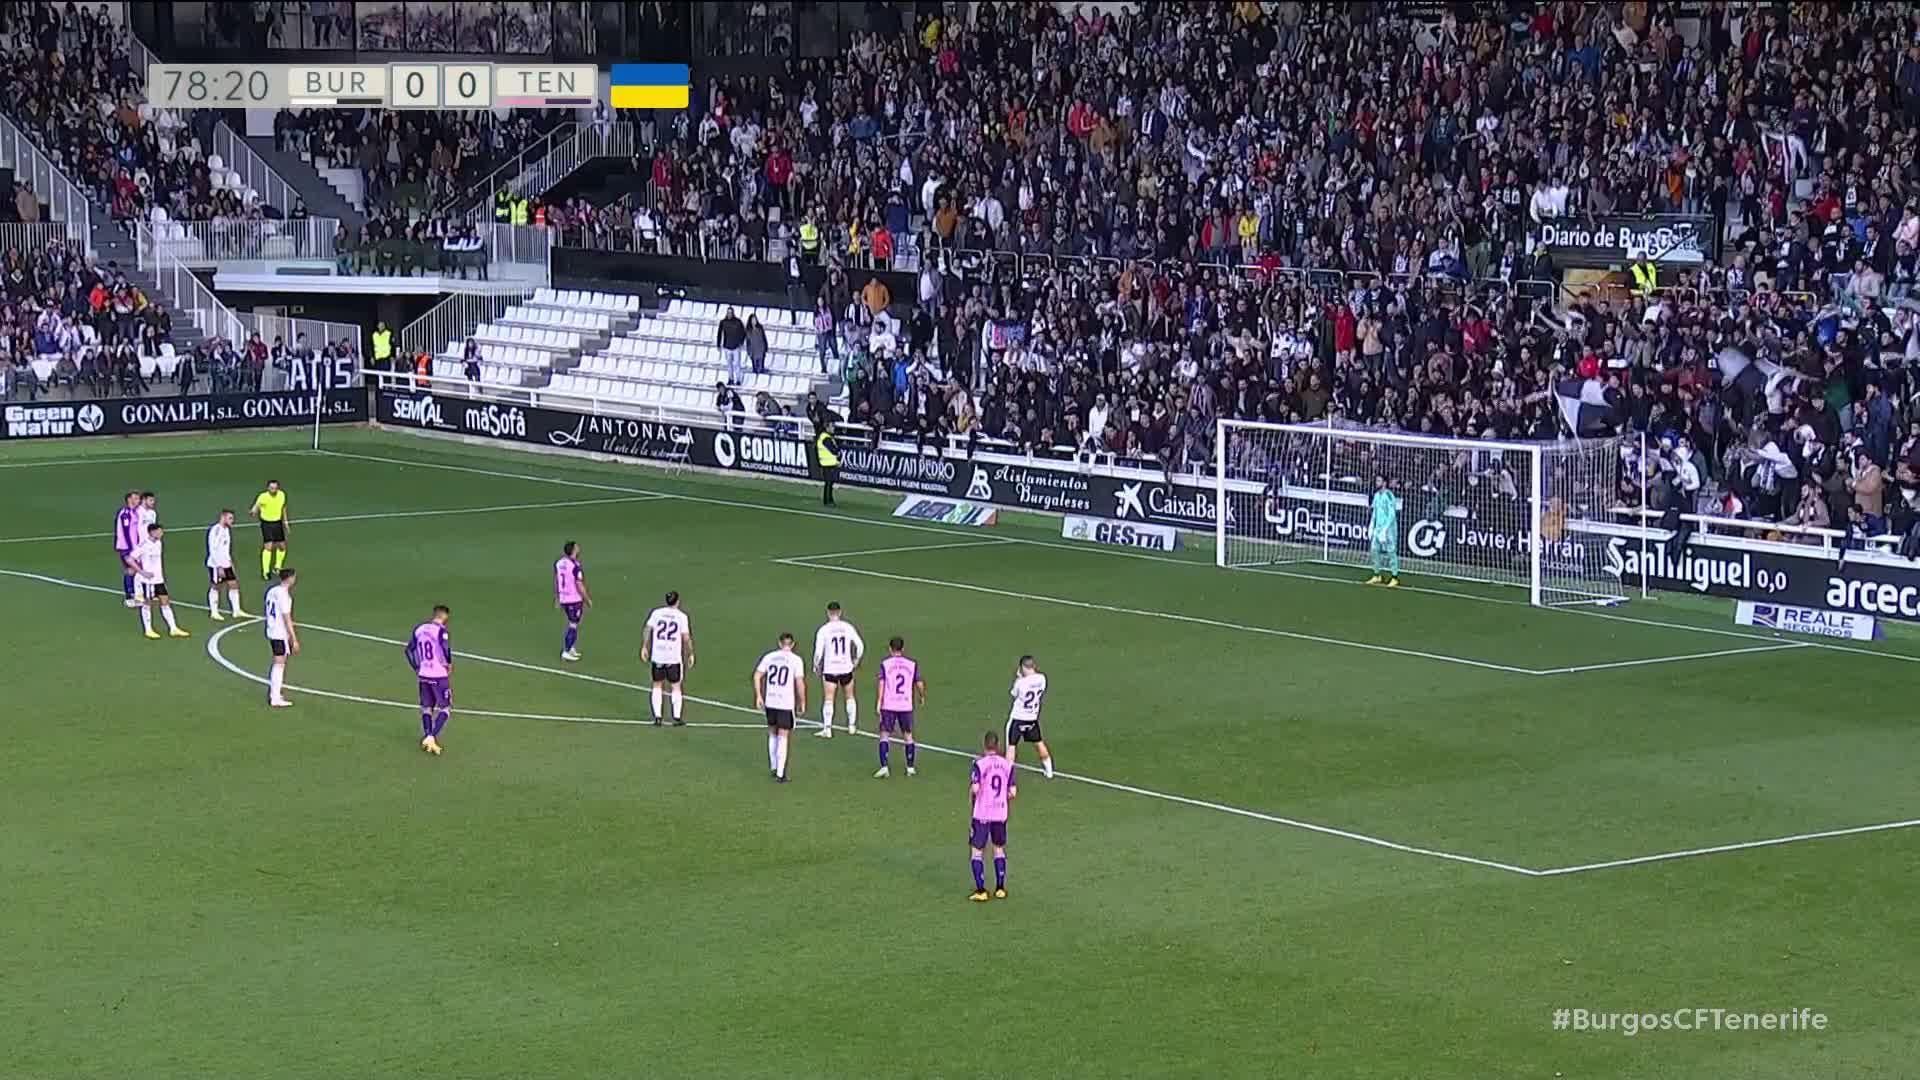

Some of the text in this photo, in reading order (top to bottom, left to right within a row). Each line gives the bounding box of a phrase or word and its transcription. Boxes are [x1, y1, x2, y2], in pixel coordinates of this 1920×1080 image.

[1542, 223, 1590, 246] Diario
[1594, 223, 1615, 248] de
[5, 405, 75, 422] Green
[121, 401, 215, 424] GONALPI,
[393, 396, 444, 427] SEMCAL
[8, 419, 75, 436] Natur
[588, 417, 695, 444] ANTONAGA
[741, 435, 808, 467] CODIMA
[838, 448, 897, 475] XCLUSIVAS
[994, 465, 1088, 490] Aislamientos
[1016, 483, 1090, 510] Burgaleses
[1150, 487, 1236, 522] CaixaBak
[1456, 523, 1514, 550] Javier
[1756, 569, 1787, 594] 0,0
[1826, 577, 1920, 617] arcec
[657, 620, 678, 641] 22
[1784, 608, 1855, 629] REALE
[419, 640, 433, 660] 18
[831, 636, 846, 656] 11
[768, 664, 789, 687] 20
[895, 673, 905, 694] 2
[991, 775, 1002, 798] 9
